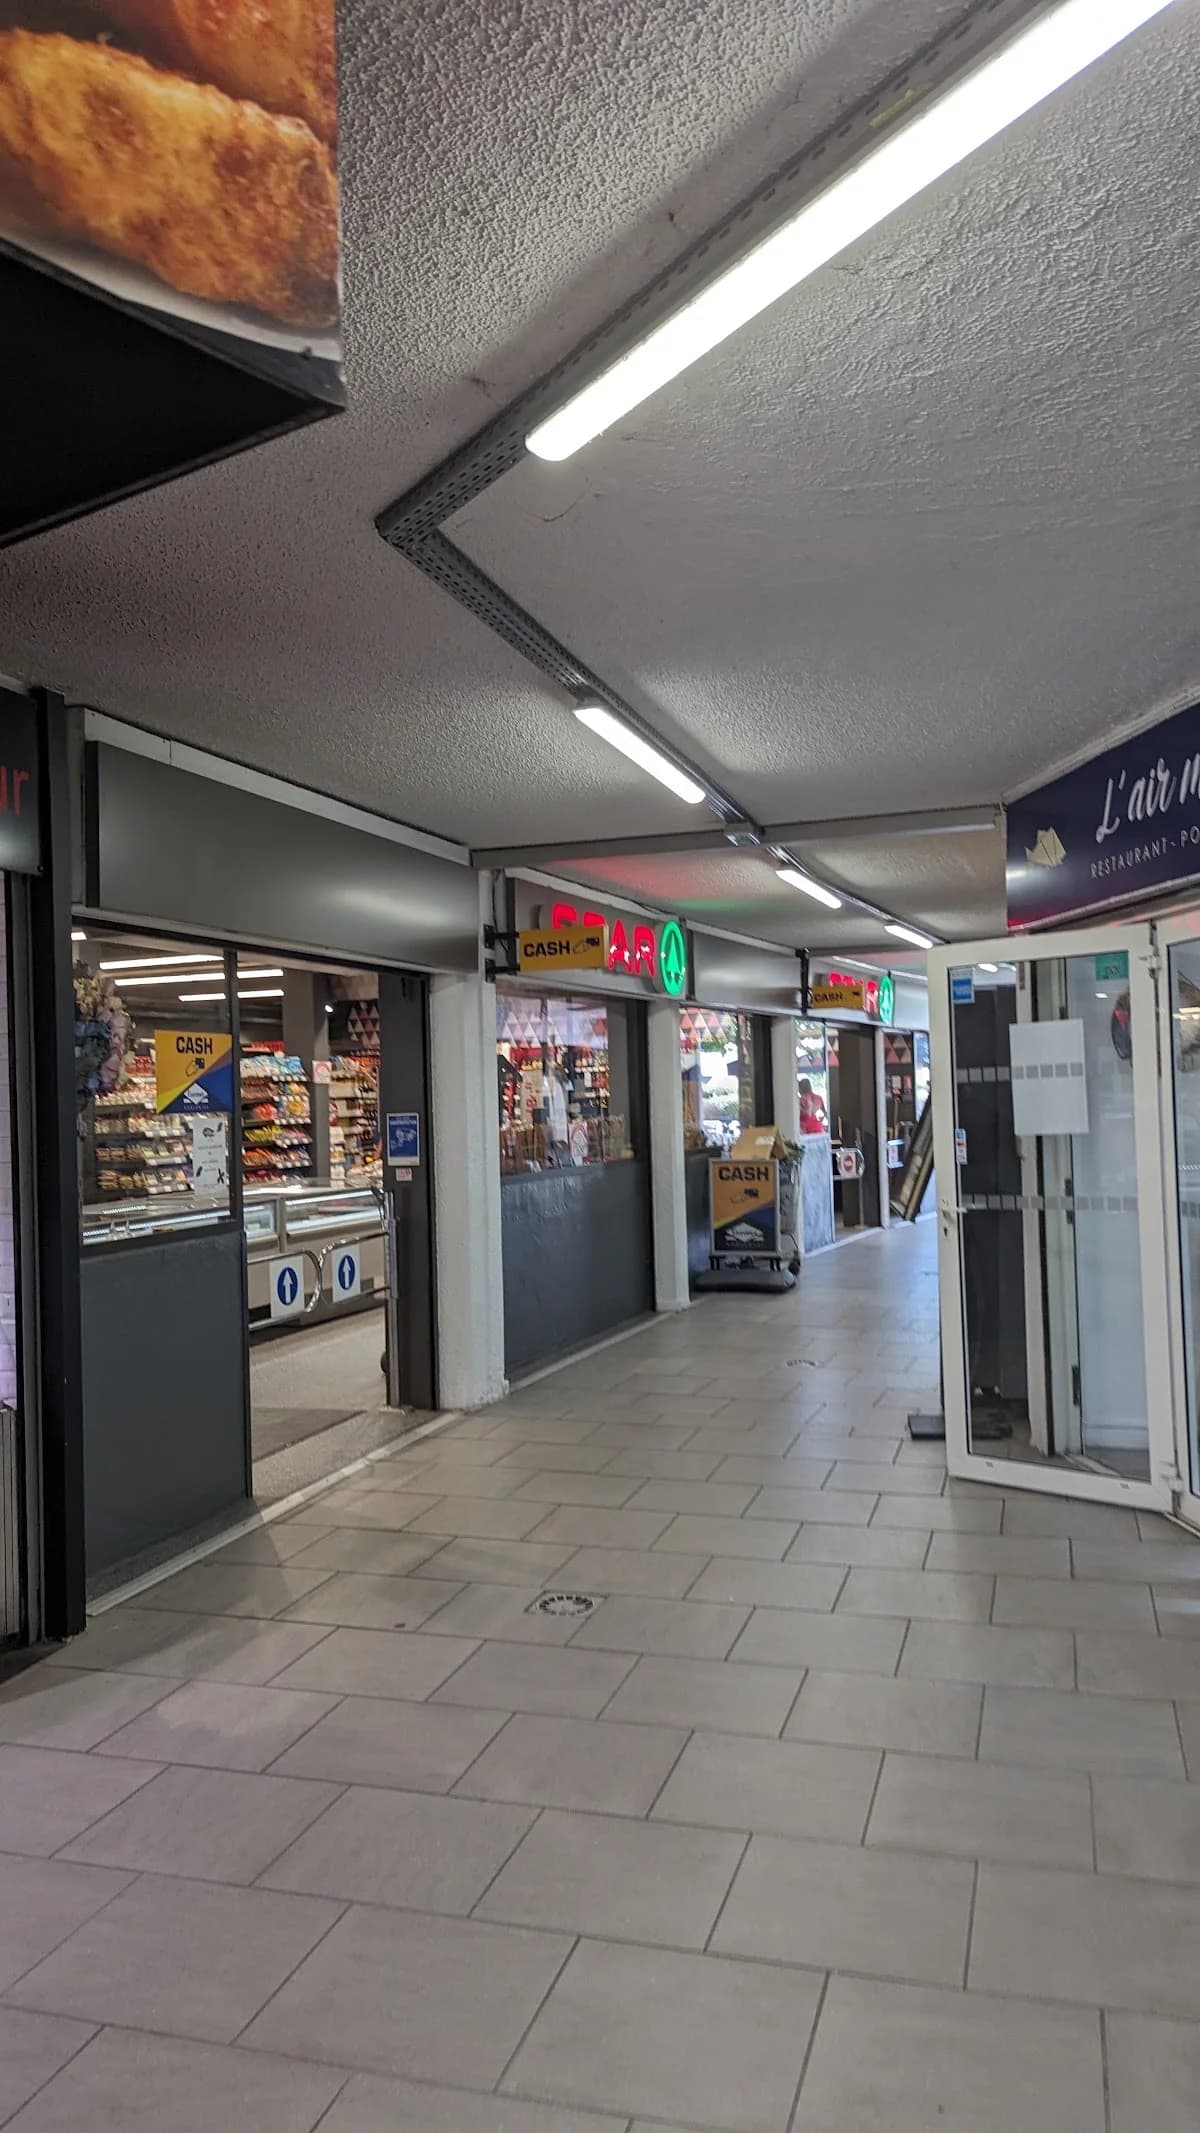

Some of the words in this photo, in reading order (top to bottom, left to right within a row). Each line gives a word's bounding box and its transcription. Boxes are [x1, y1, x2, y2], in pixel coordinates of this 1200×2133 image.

[0, 765, 30, 817] r
[1096, 757, 1177, 844] L'air
[1090, 837, 1167, 879] RESTAURANT
[523, 940, 571, 958] CASH
[552, 902, 656, 977] AR
[176, 1036, 213, 1055] CASH
[718, 1166, 769, 1181] CASH
